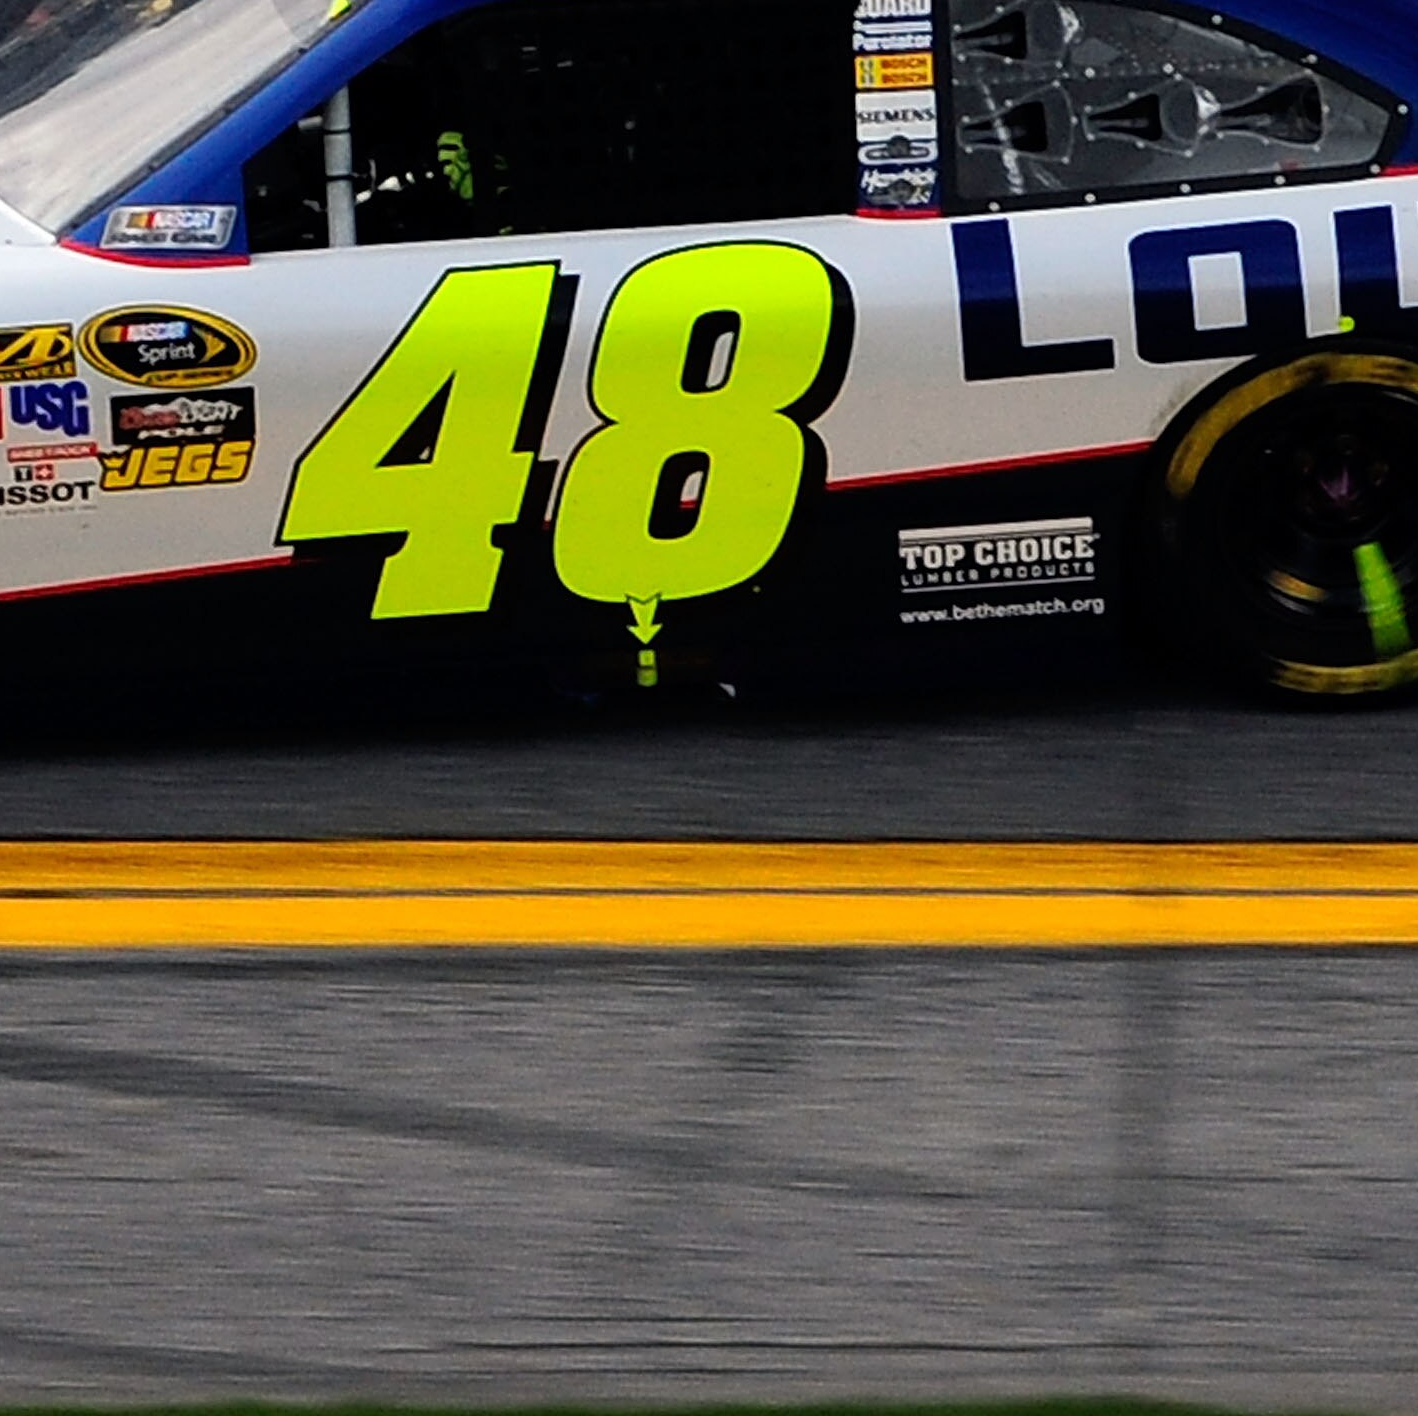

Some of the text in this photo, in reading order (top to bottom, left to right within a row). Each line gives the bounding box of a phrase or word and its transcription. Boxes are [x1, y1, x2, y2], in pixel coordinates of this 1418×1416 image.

[857, 107, 935, 124] SIEMENS
[137, 342, 196, 366] Sprint
[9, 381, 91, 437] USG
[275, 239, 855, 621] 48
[101, 440, 254, 490] JEGS
[899, 535, 1096, 570] TOP CHOICE
[900, 561, 1096, 587] LUMBER PRODUCTS
[899, 597, 1105, 624] www.bethematch.org
